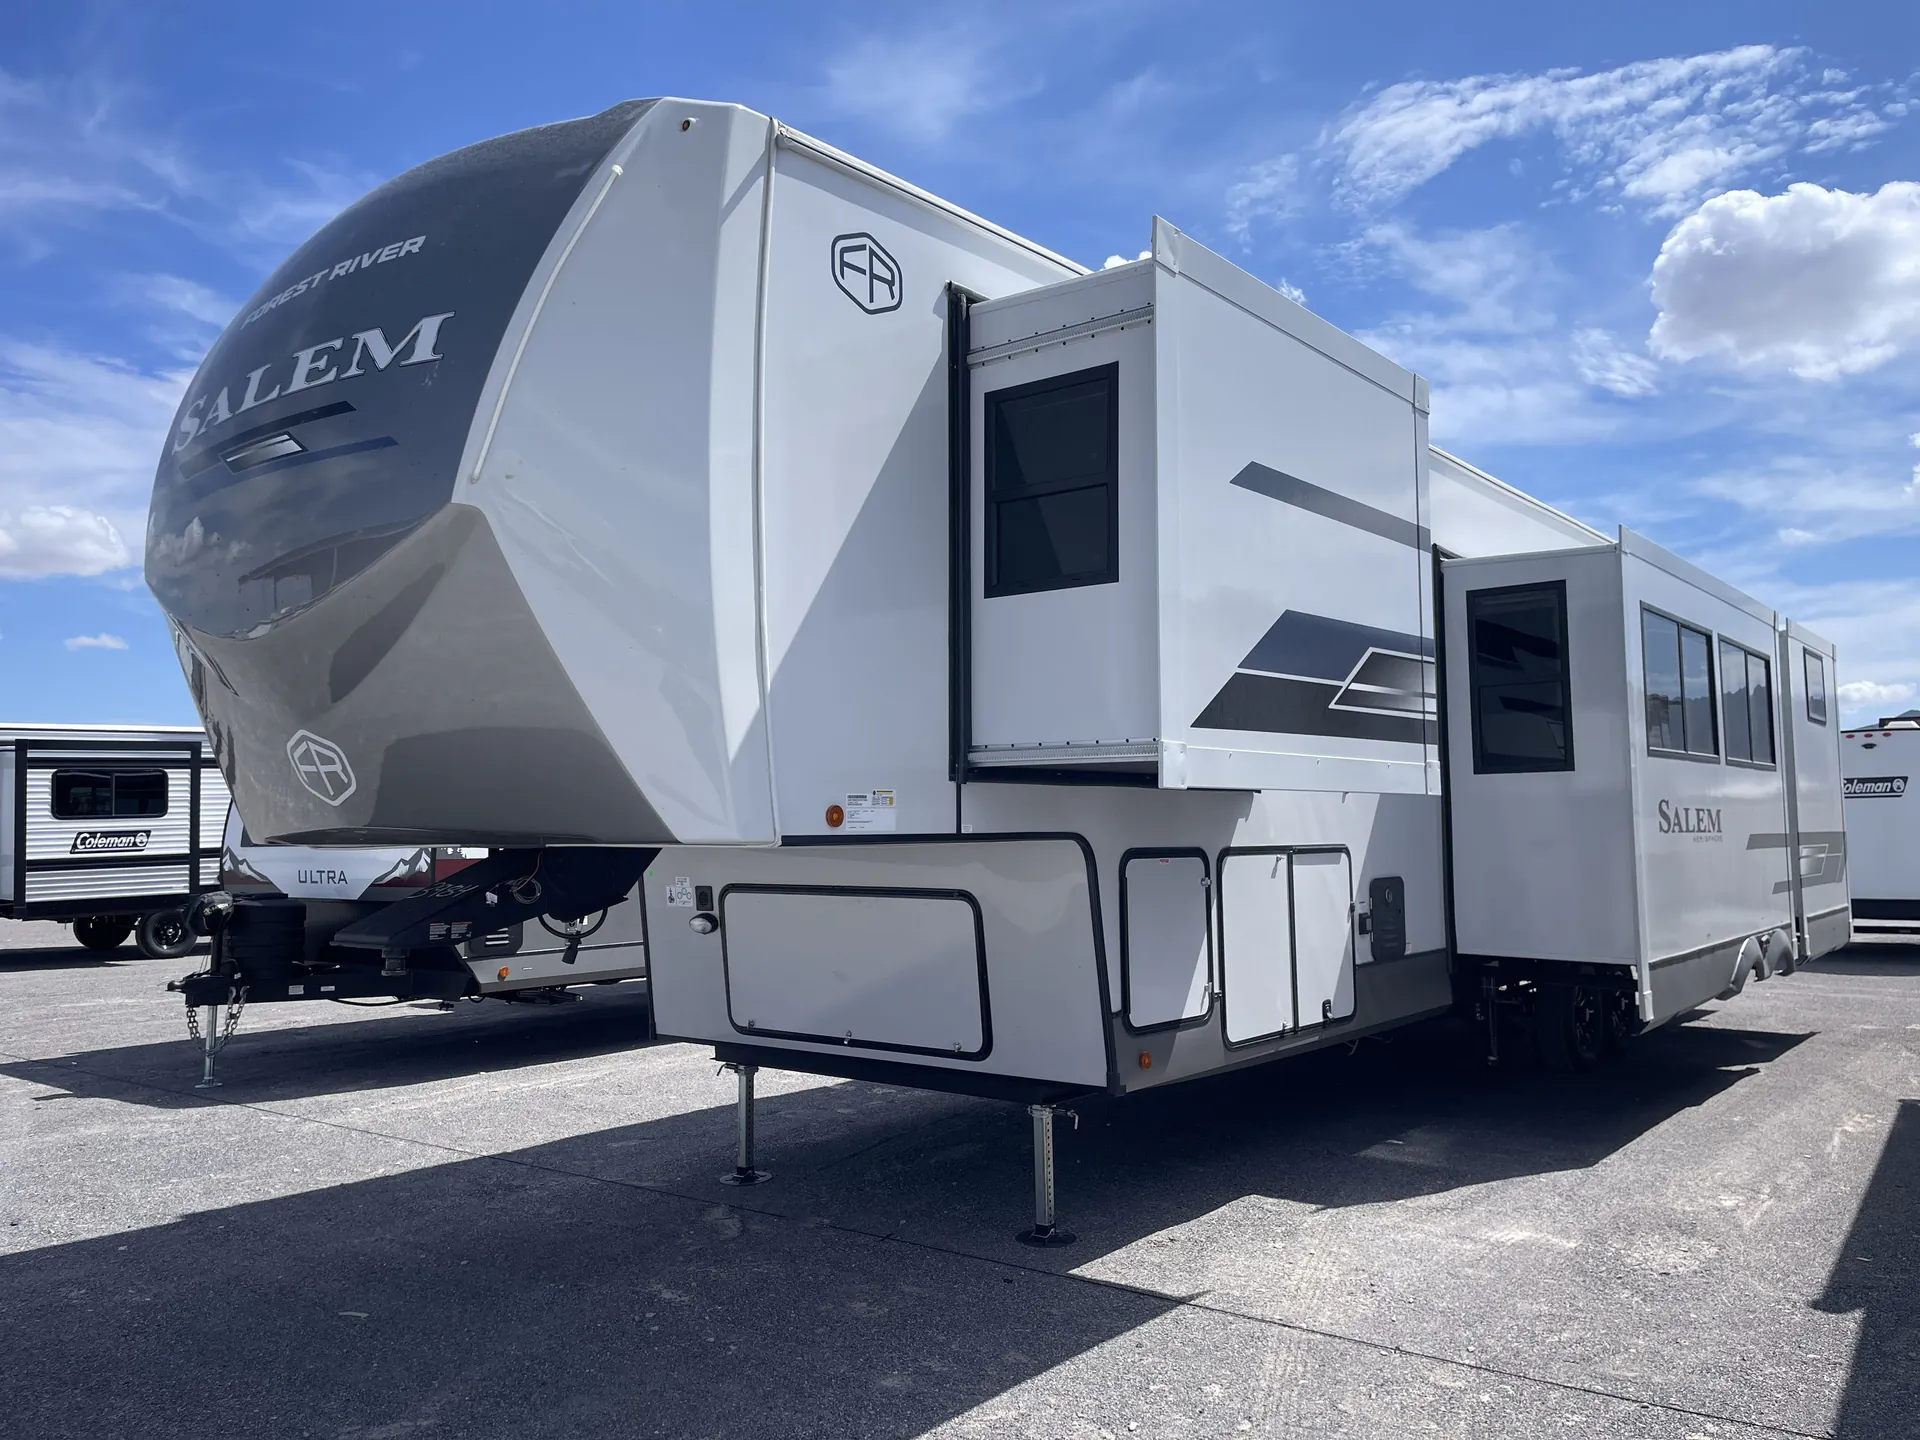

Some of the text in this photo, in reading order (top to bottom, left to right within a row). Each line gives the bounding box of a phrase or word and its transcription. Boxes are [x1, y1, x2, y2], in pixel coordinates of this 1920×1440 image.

[241, 235, 427, 331] FOREST RIVER
[172, 310, 456, 456] SALEM
[1658, 799, 1722, 834] SALEM
[76, 832, 135, 850] Coleman
[297, 869, 348, 885] ULTRA
